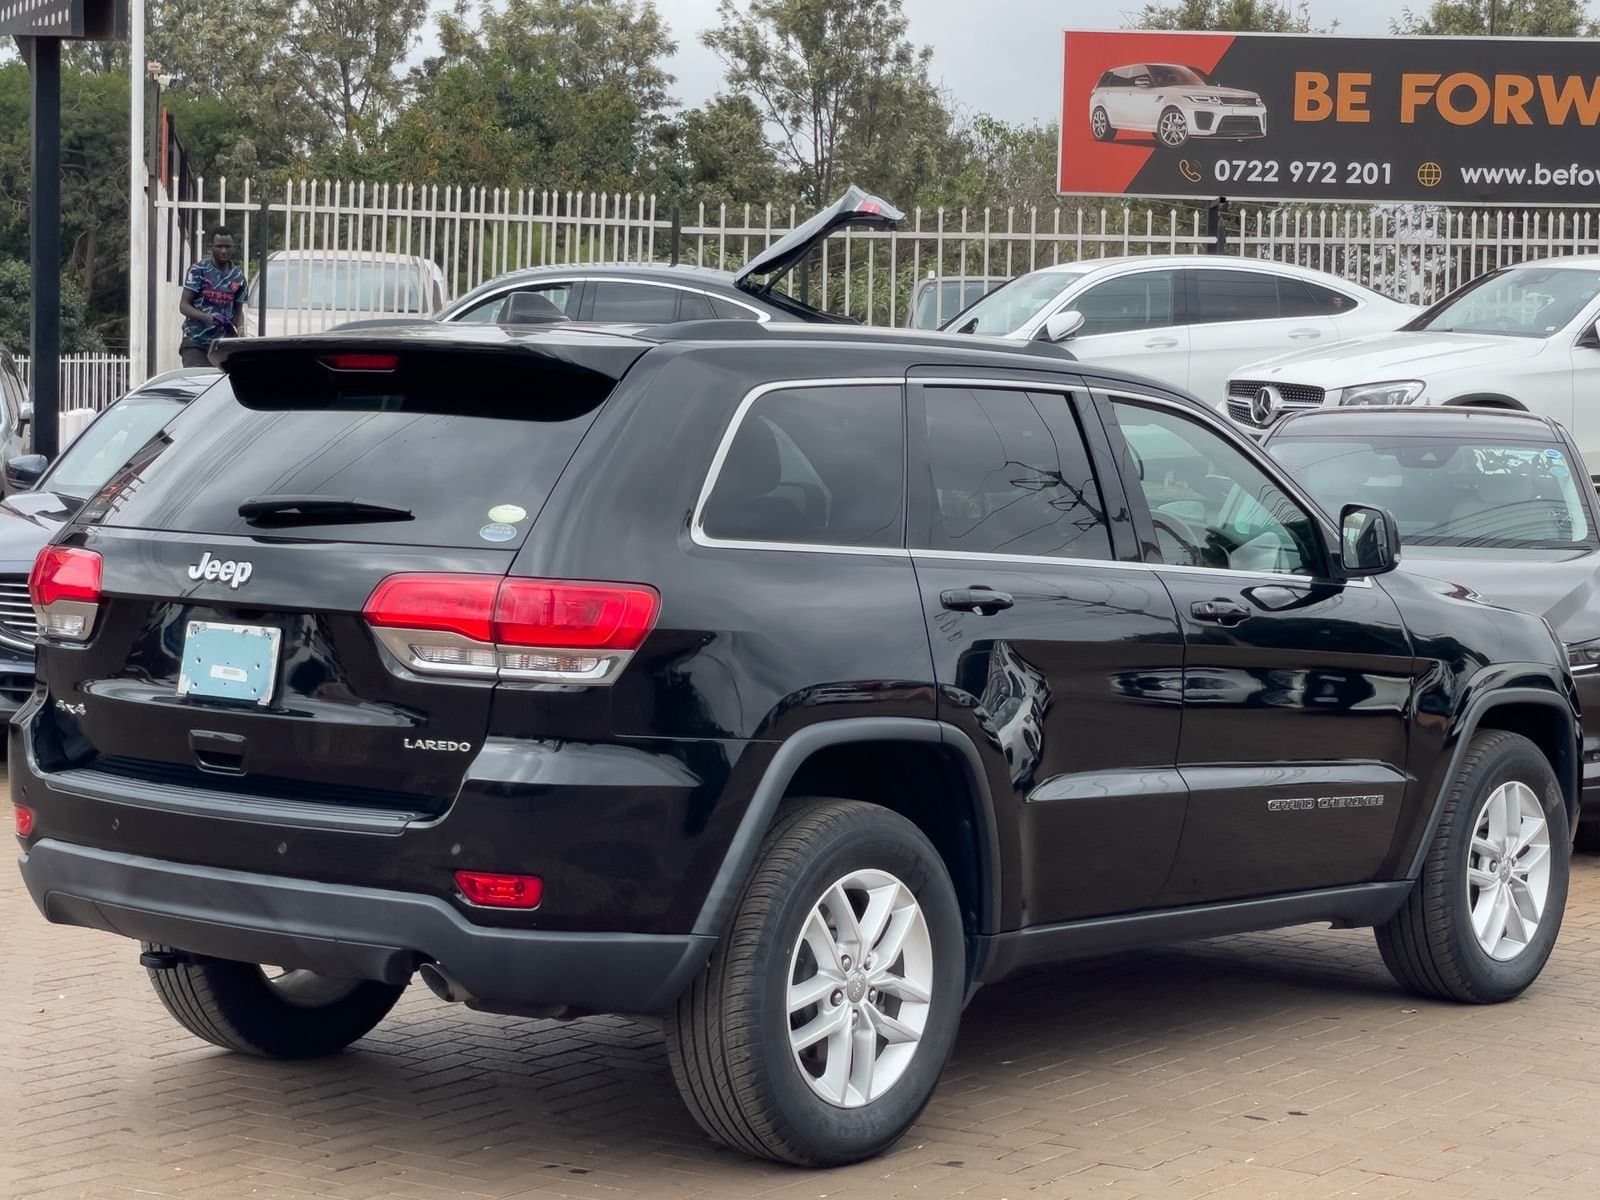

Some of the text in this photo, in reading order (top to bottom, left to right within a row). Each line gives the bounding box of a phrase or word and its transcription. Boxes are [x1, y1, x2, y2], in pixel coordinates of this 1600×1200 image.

[1293, 71, 1600, 126] BE FORW
[1214, 159, 1392, 185] 0722 972 201
[1460, 162, 1600, 186] www.befo
[188, 551, 253, 589] Jeep
[403, 738, 472, 753] LAREDO
[1267, 798, 1315, 811] GRAND
